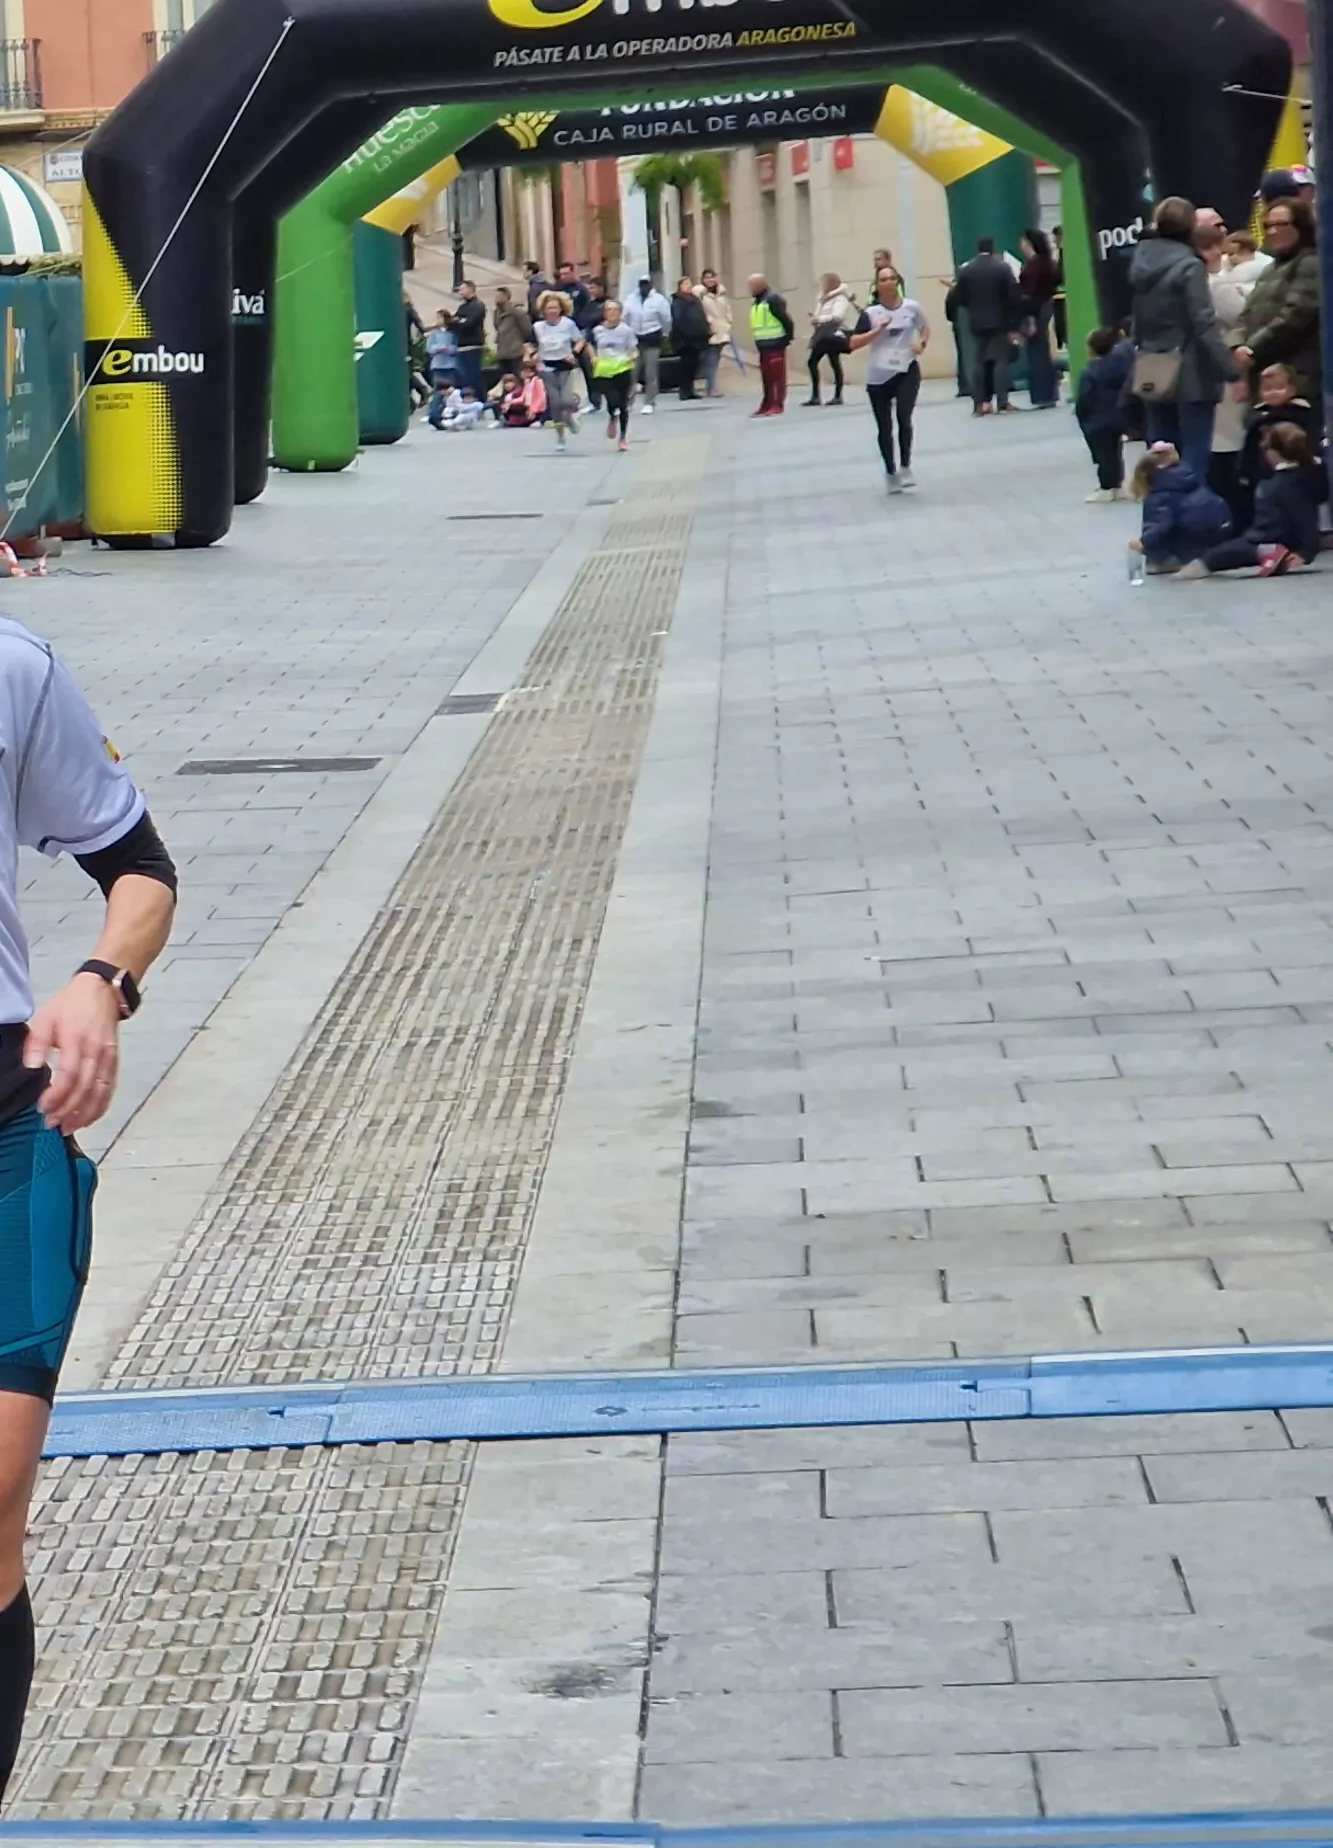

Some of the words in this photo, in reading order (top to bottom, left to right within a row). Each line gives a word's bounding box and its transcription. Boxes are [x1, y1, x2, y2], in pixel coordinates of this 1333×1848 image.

[493, 46, 565, 67] PÁSATE
[566, 46, 581, 62] A
[585, 43, 609, 60] LA
[612, 32, 733, 58] OPERADORA
[736, 21, 857, 47] ARAGONESA
[553, 127, 615, 146] CAJA
[621, 117, 700, 140] RURAL
[707, 114, 738, 132] DE
[746, 102, 847, 128] ARAGÓN
[101, 344, 205, 376] embou
